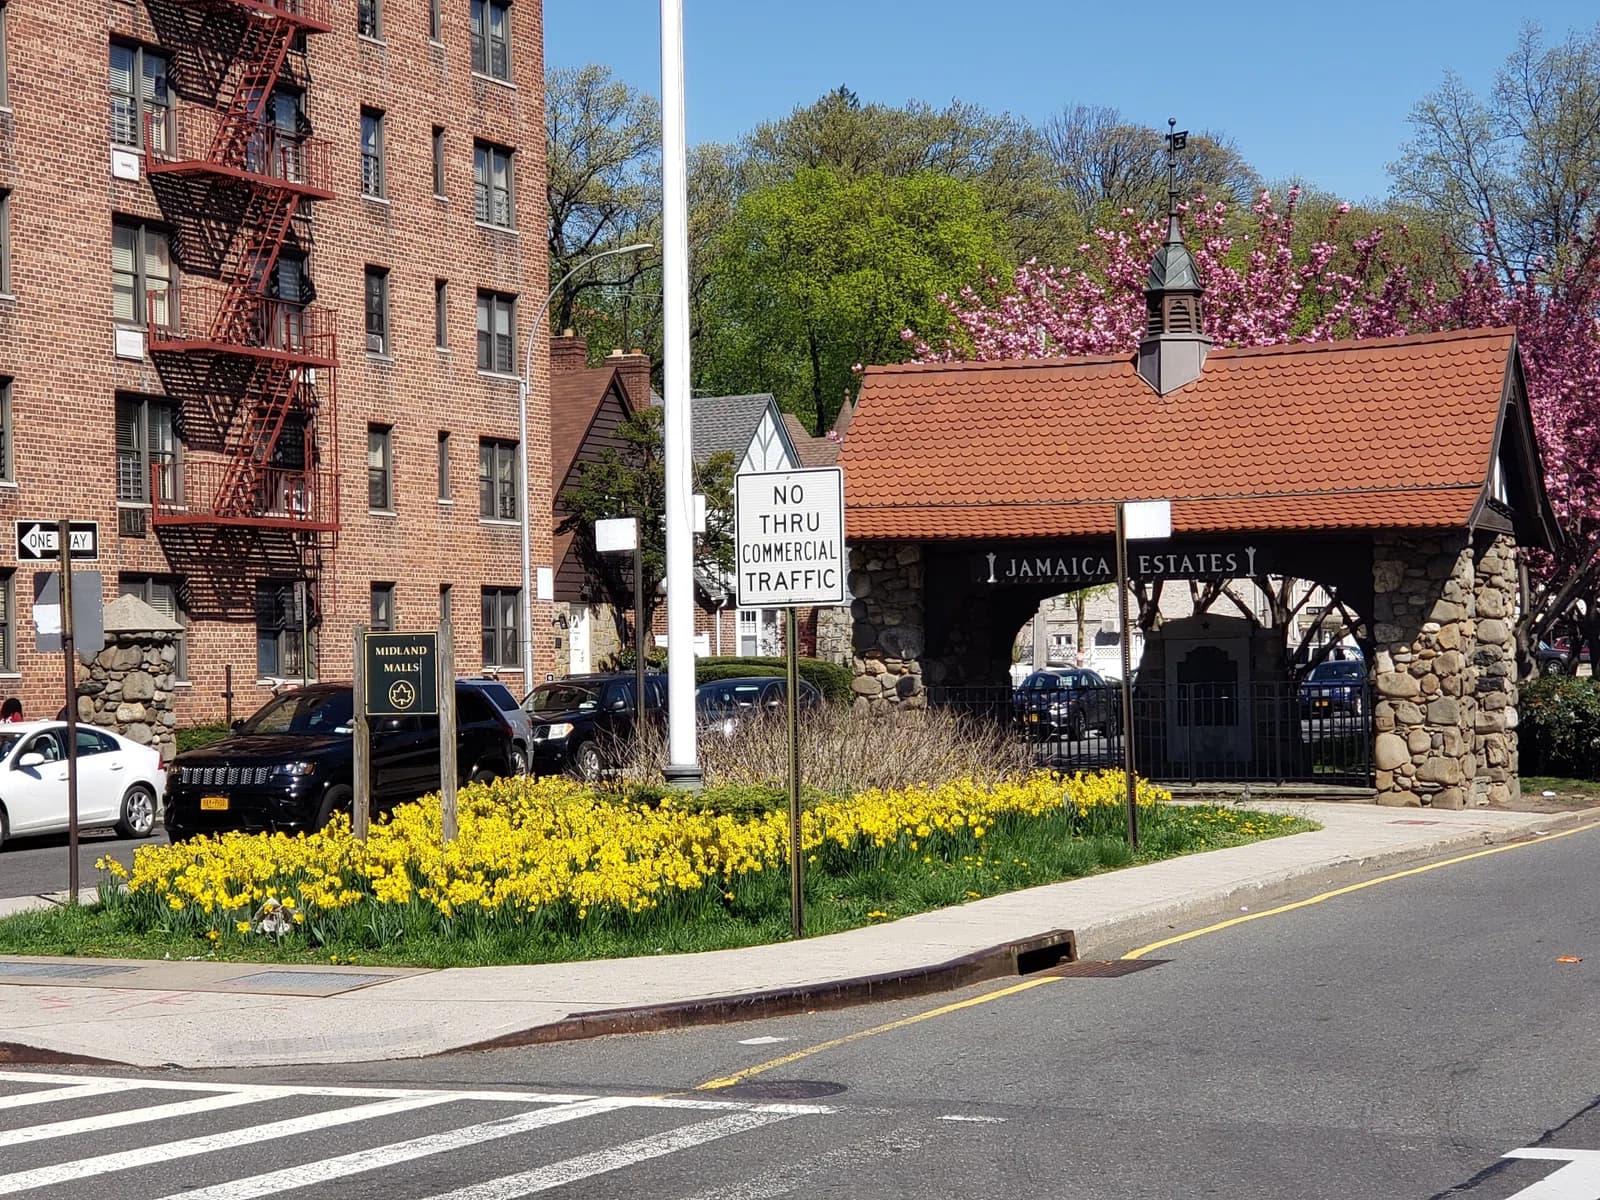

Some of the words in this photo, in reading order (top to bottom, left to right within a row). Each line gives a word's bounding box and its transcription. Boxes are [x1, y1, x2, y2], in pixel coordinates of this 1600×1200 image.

[774, 484, 804, 505] NO
[759, 511, 820, 534] THRU
[29, 533, 53, 548] ONE
[69, 533, 87, 548] AY
[742, 540, 838, 564] COMMERCIAL
[1005, 557, 1112, 577] JAMAICA
[1138, 553, 1238, 574] ESTATES
[745, 568, 836, 592] TRAFFIC
[375, 645, 428, 656] MIDLAND
[383, 662, 420, 673] MALLS
